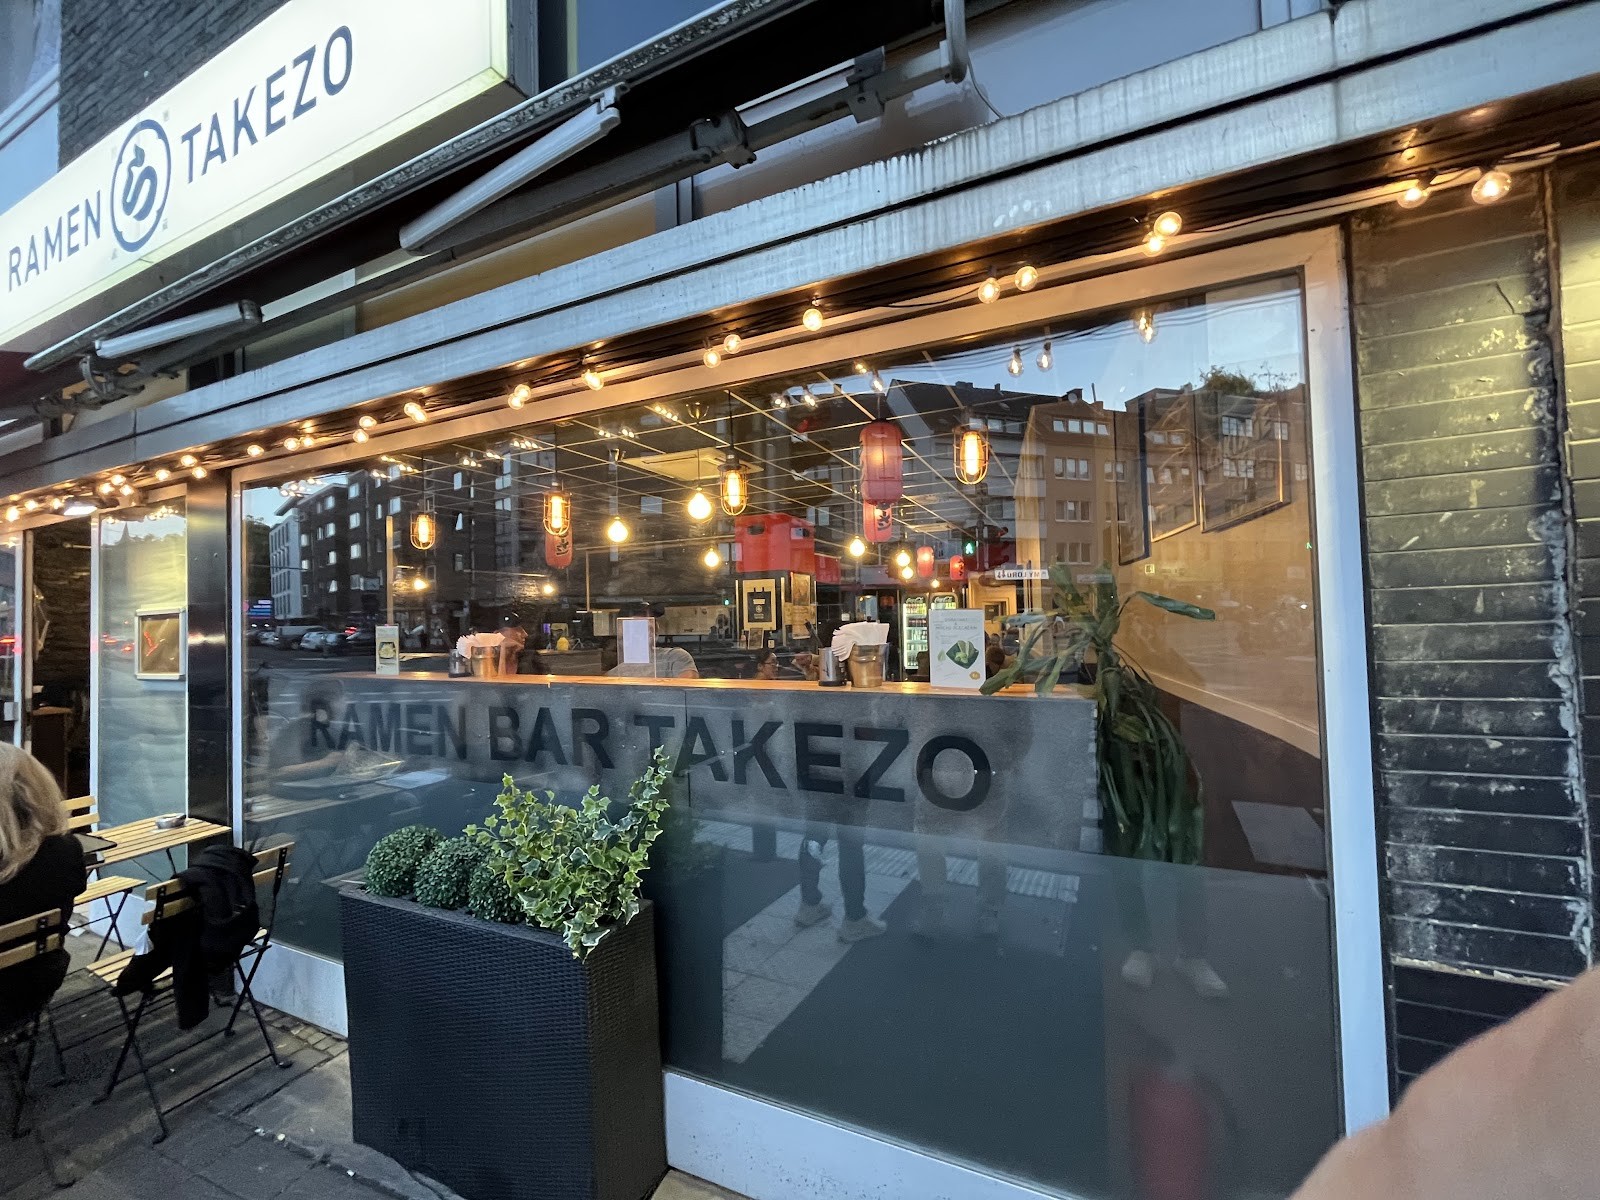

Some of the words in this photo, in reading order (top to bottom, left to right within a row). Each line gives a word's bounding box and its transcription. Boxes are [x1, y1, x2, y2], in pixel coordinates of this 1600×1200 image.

[8, 190, 102, 292] RAMEN
[180, 25, 354, 184] TAKEZO
[310, 701, 468, 761] RAMEN
[488, 706, 616, 770] BAR
[633, 714, 992, 812] TAKEZO
